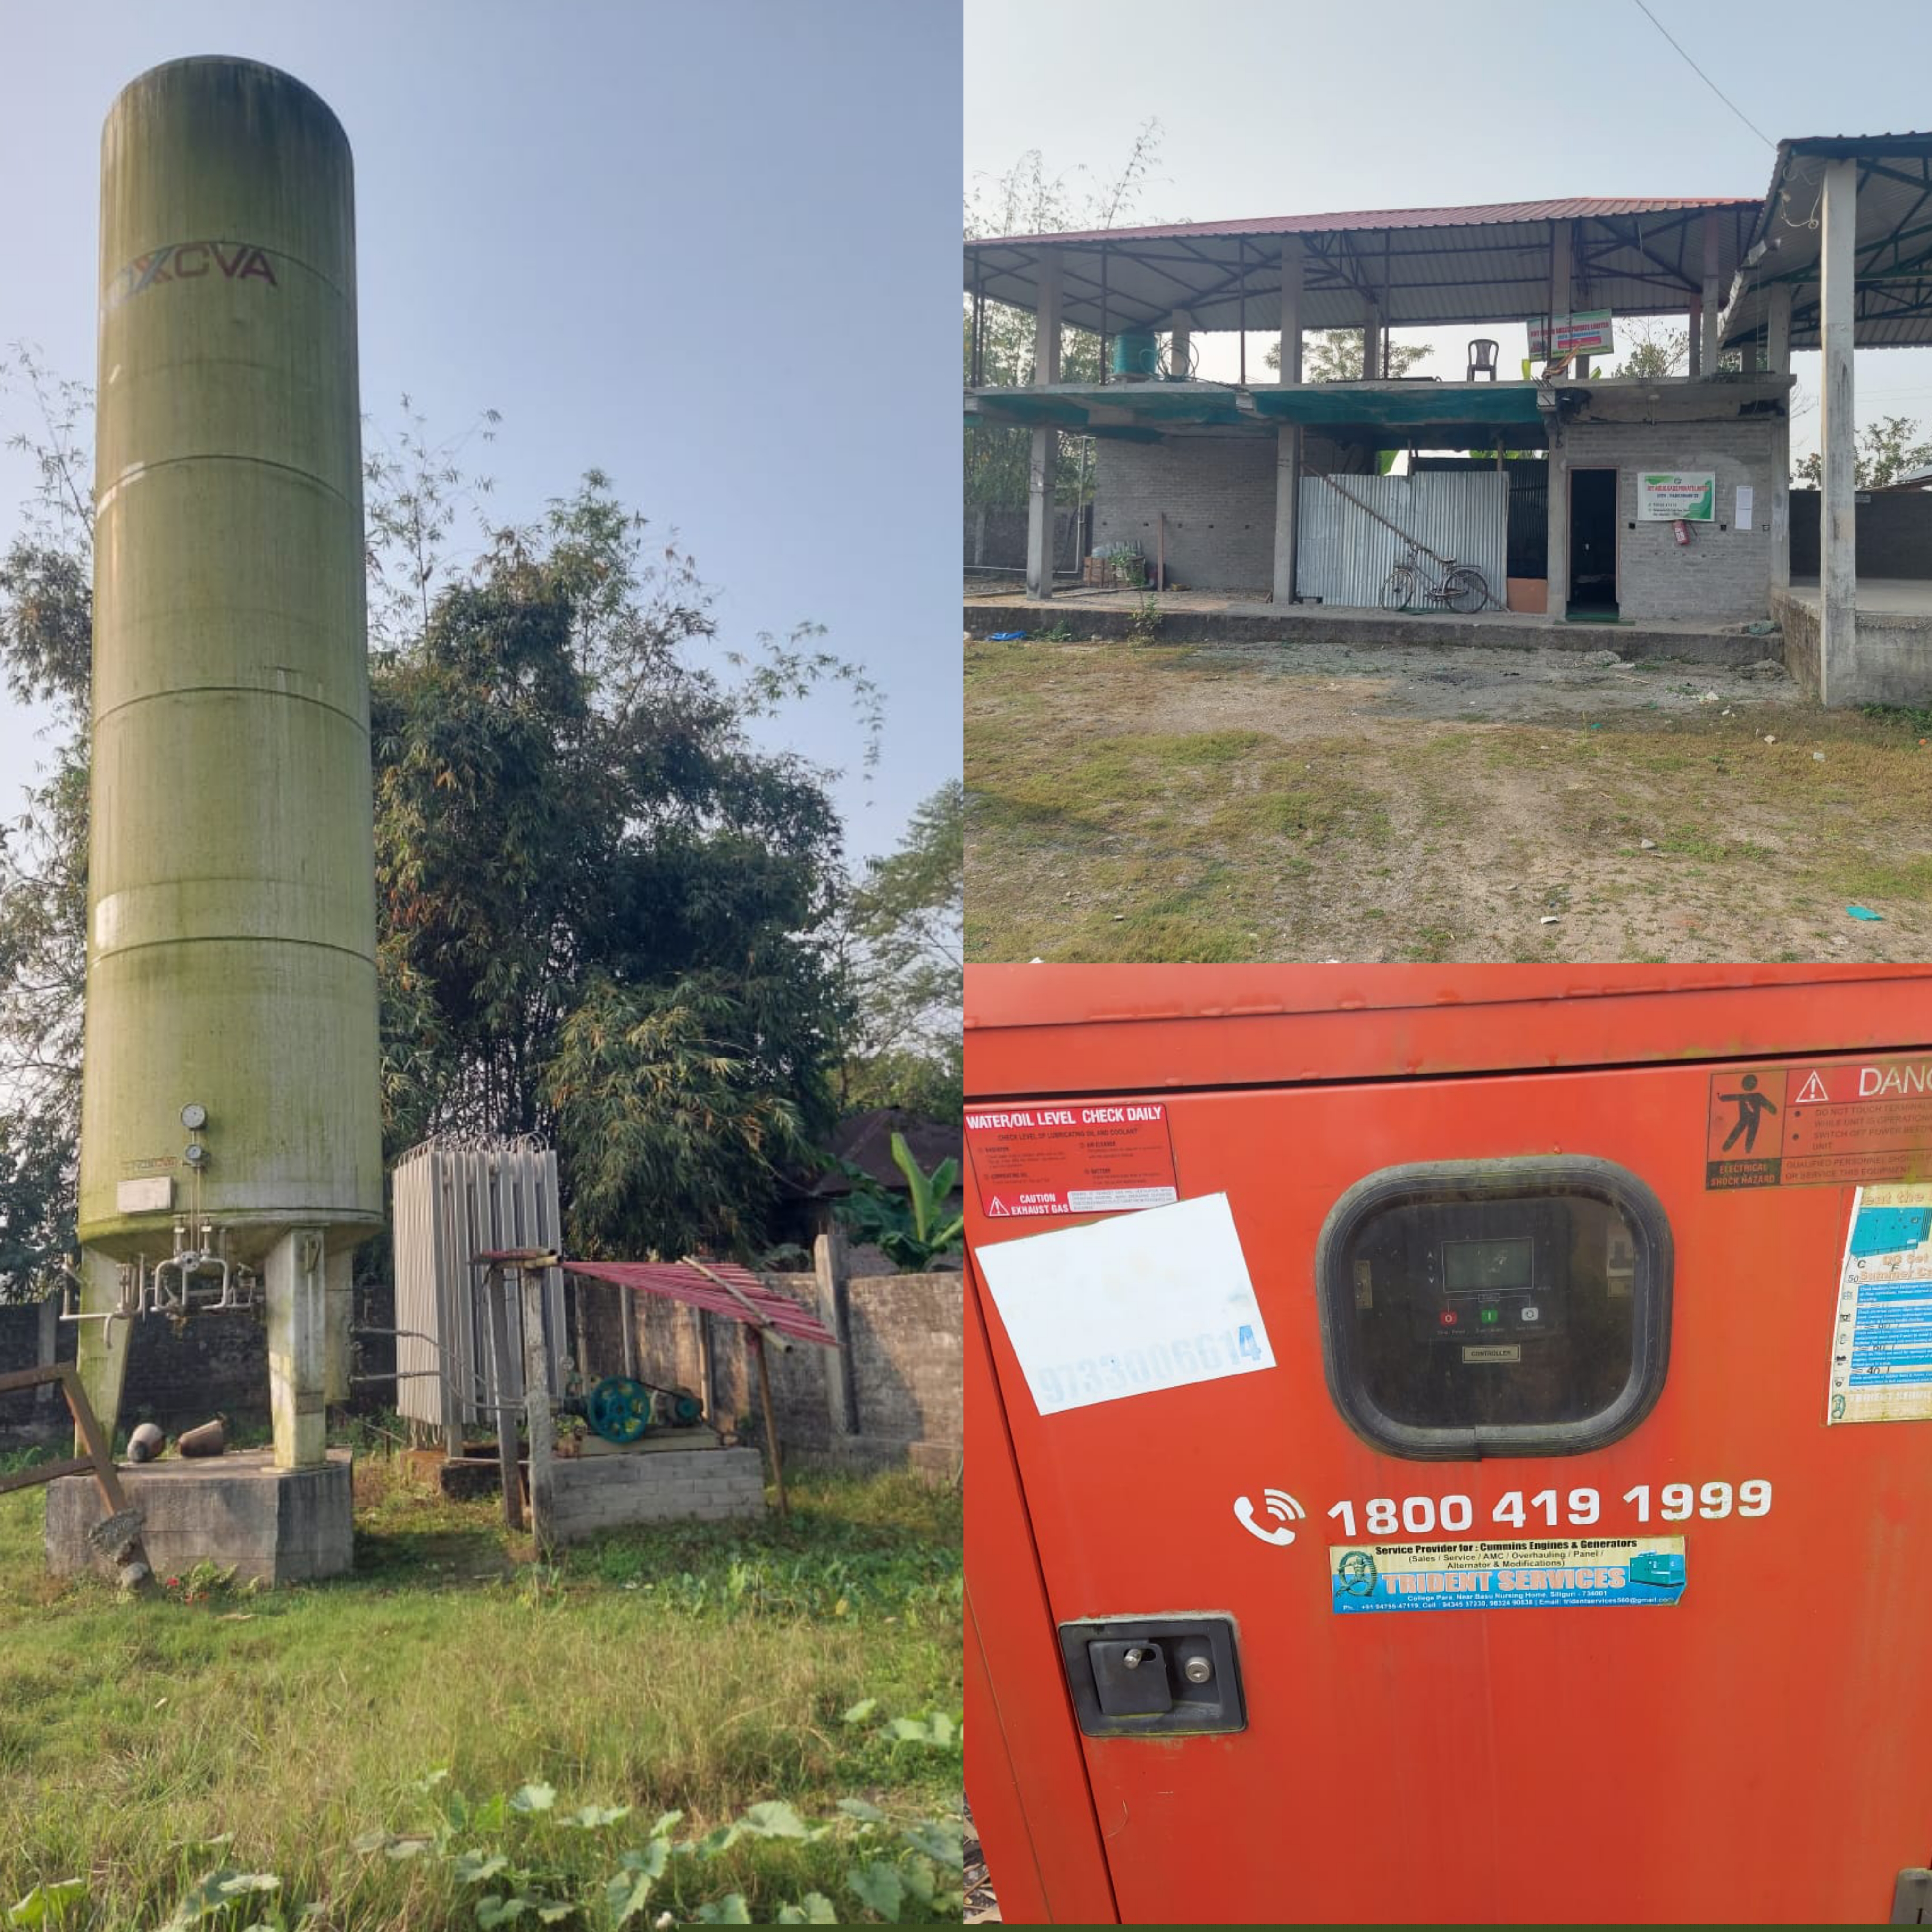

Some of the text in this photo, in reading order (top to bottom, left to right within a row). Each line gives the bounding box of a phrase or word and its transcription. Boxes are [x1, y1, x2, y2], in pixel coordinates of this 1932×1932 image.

[966, 1106, 1161, 1129] WATER/OIL LEVEL CHECK DAILY
[1020, 1193, 1056, 1204] CAUTION
[1011, 1203, 1069, 1216] EXHAUST GAS
[1327, 1479, 1772, 1537] 1800 419 1999
[1375, 1546, 1413, 1555] Service
[1416, 1544, 1457, 1554] Provider
[1459, 1544, 1473, 1552] for
[1480, 1542, 1527, 1552] Cummins
[1529, 1541, 1569, 1550] Engines
[1581, 1540, 1637, 1549] Generators
[1408, 1555, 1436, 1564] (Sales
[1444, 1553, 1475, 1561] Service
[1512, 1551, 1566, 1559] Overhauling
[1447, 1561, 1491, 1569] Alternator
[1502, 1558, 1565, 1567] Modifications)
[1382, 1567, 1626, 1595] TRIDENT SERVICES
